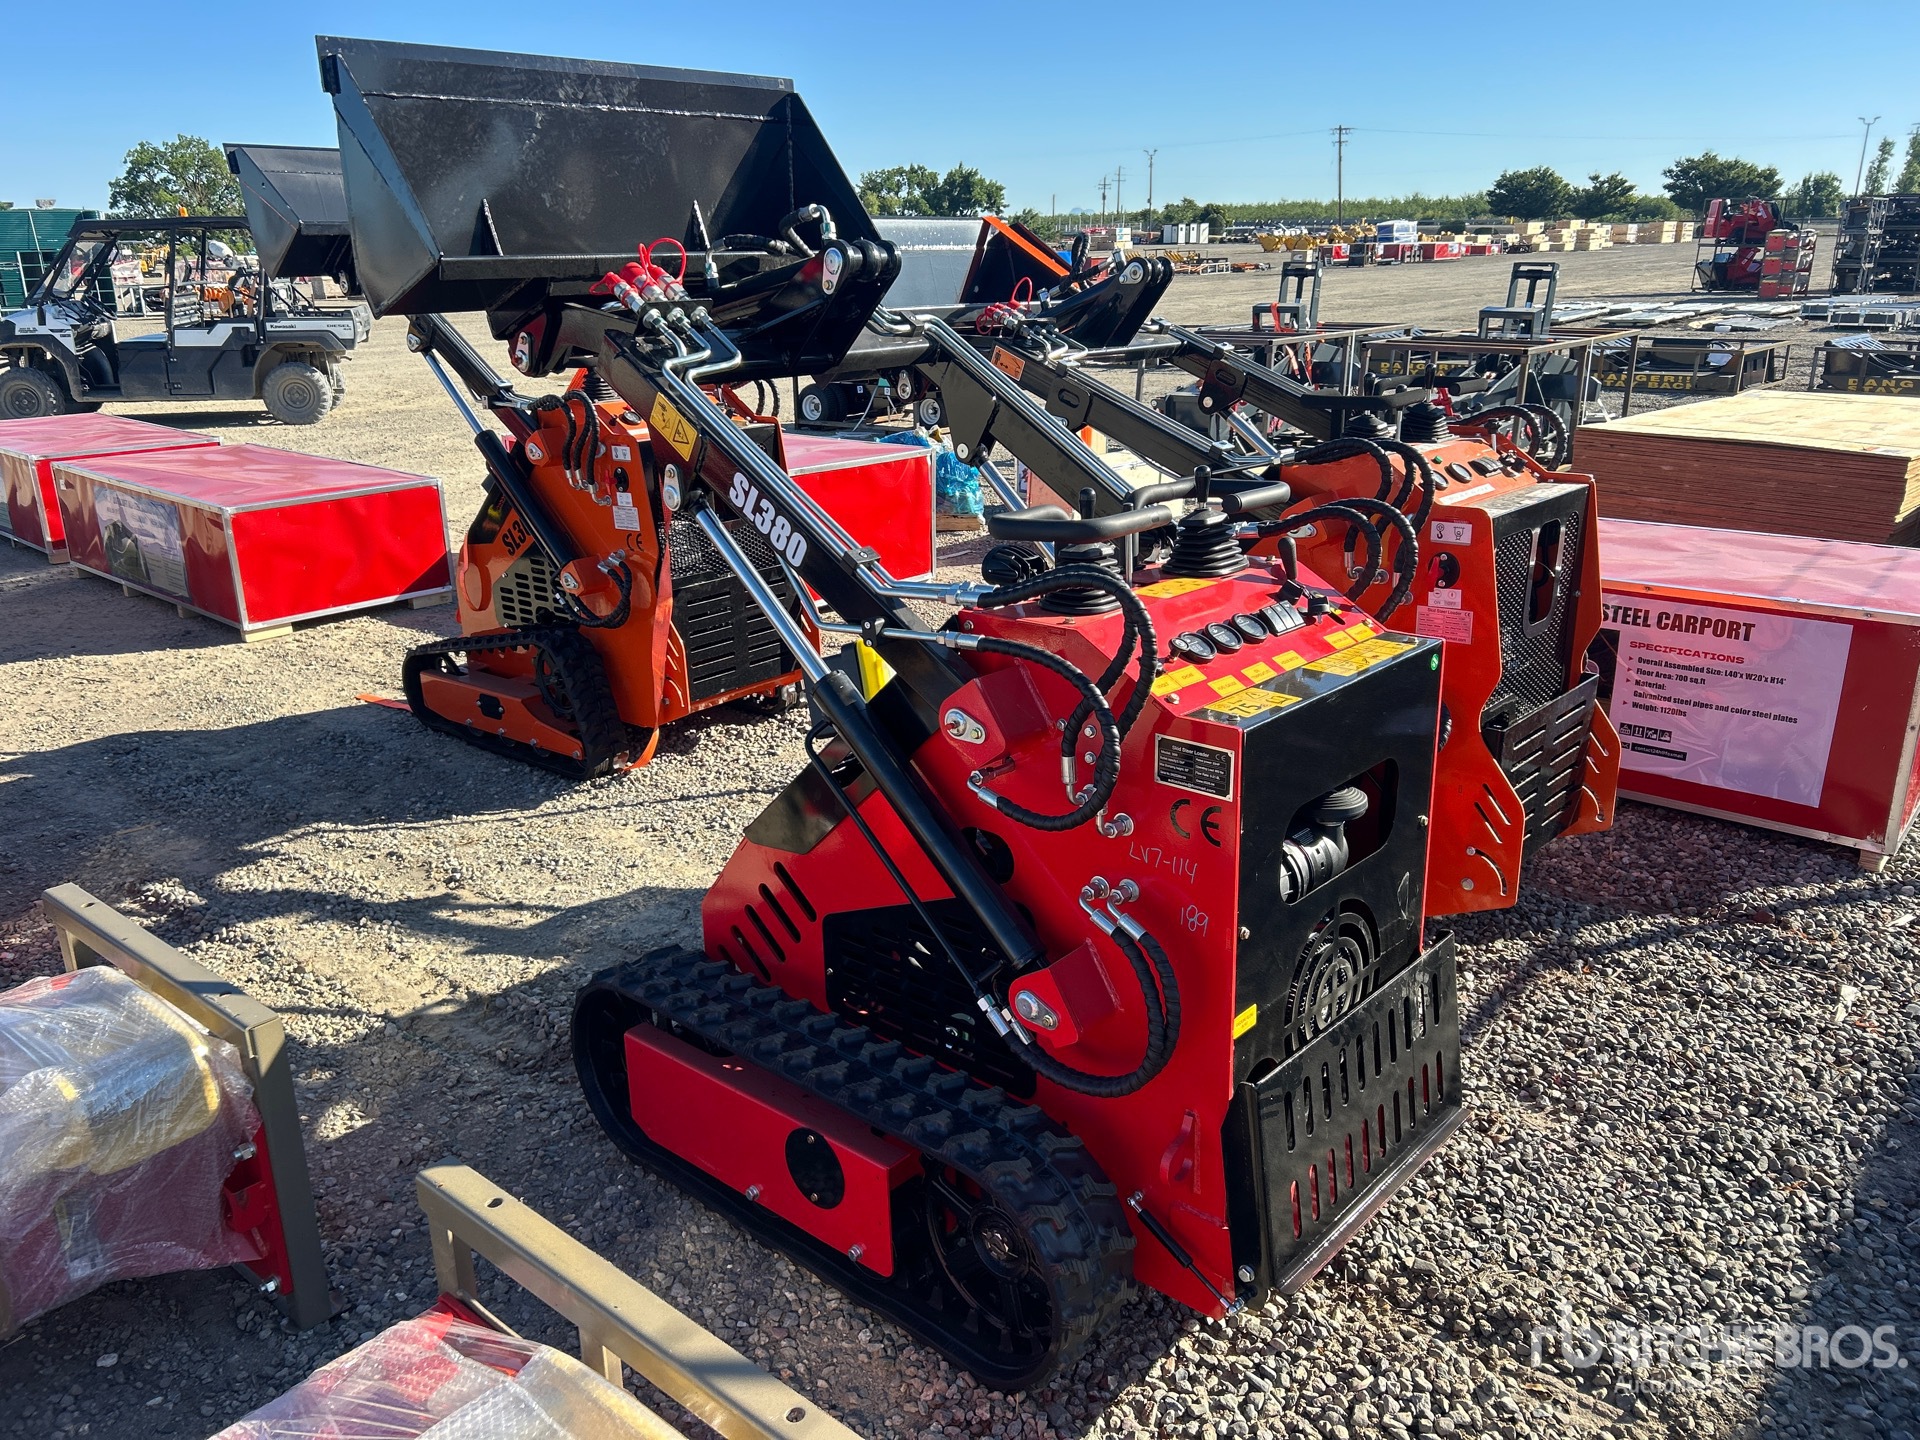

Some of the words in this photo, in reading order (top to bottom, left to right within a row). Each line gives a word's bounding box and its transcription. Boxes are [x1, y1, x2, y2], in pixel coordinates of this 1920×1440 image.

[729, 471, 808, 568] SL380
[1602, 603, 1651, 628] STEEL
[1656, 611, 1756, 641] CARPORT
[1629, 641, 1745, 664] SPECIFICATIONS
[1636, 667, 1654, 677] Floor
[1654, 670, 1674, 680] Area:
[1675, 673, 1688, 682] 700
[1637, 656, 1663, 667] Overall
[1664, 661, 1705, 674] Assembled
[1705, 667, 1724, 676] Size:
[1634, 679, 1667, 690] Material:
[1631, 701, 1659, 713] Weight:
[1659, 706, 1687, 717] 1120lbs
[1633, 690, 1672, 702] Galvanized
[1672, 697, 1692, 706] steel
[1692, 699, 1713, 710] pipes
[1714, 704, 1729, 712] and
[1730, 706, 1751, 716] color
[1751, 710, 1772, 719] steel
[1772, 713, 1798, 724] plates
[1180, 905, 1209, 937] 189
